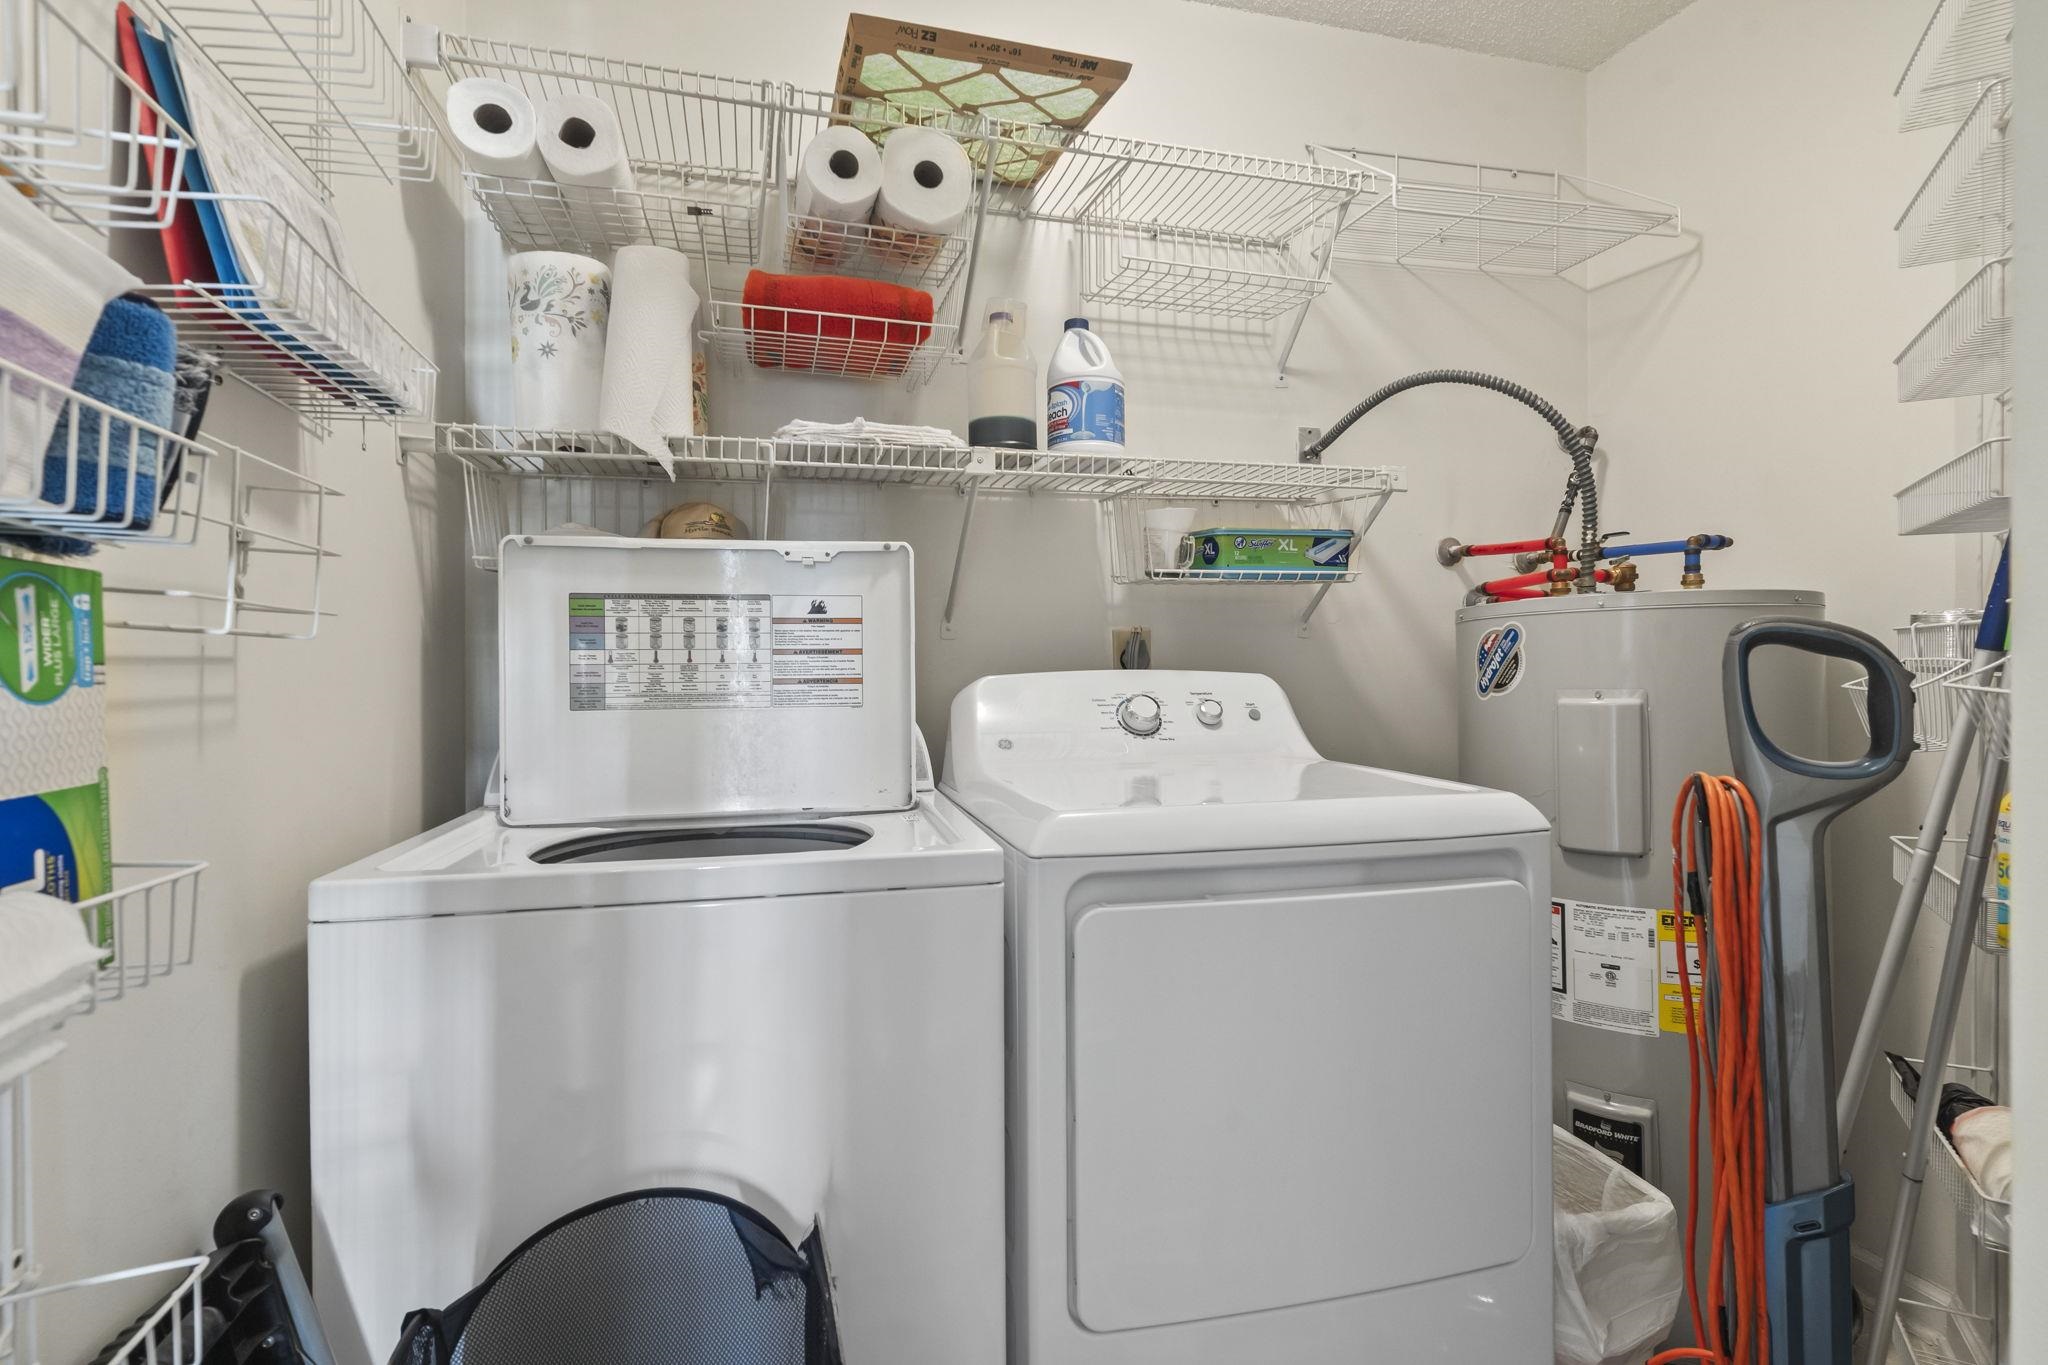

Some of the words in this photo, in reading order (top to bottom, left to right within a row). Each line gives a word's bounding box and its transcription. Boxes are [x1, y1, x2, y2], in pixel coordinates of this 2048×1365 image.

[921, 30, 937, 42] EZ
[1204, 543, 1215, 555] XL
[1278, 539, 1298, 552] XL
[49, 599, 63, 647] LARGE
[40, 617, 53, 667] WIDER
[52, 650, 64, 686] PLUS
[1480, 647, 1504, 689] Hydrojet
[1575, 1120, 1613, 1137] BRADFORD
[1614, 1132, 1640, 1142] WHITE
